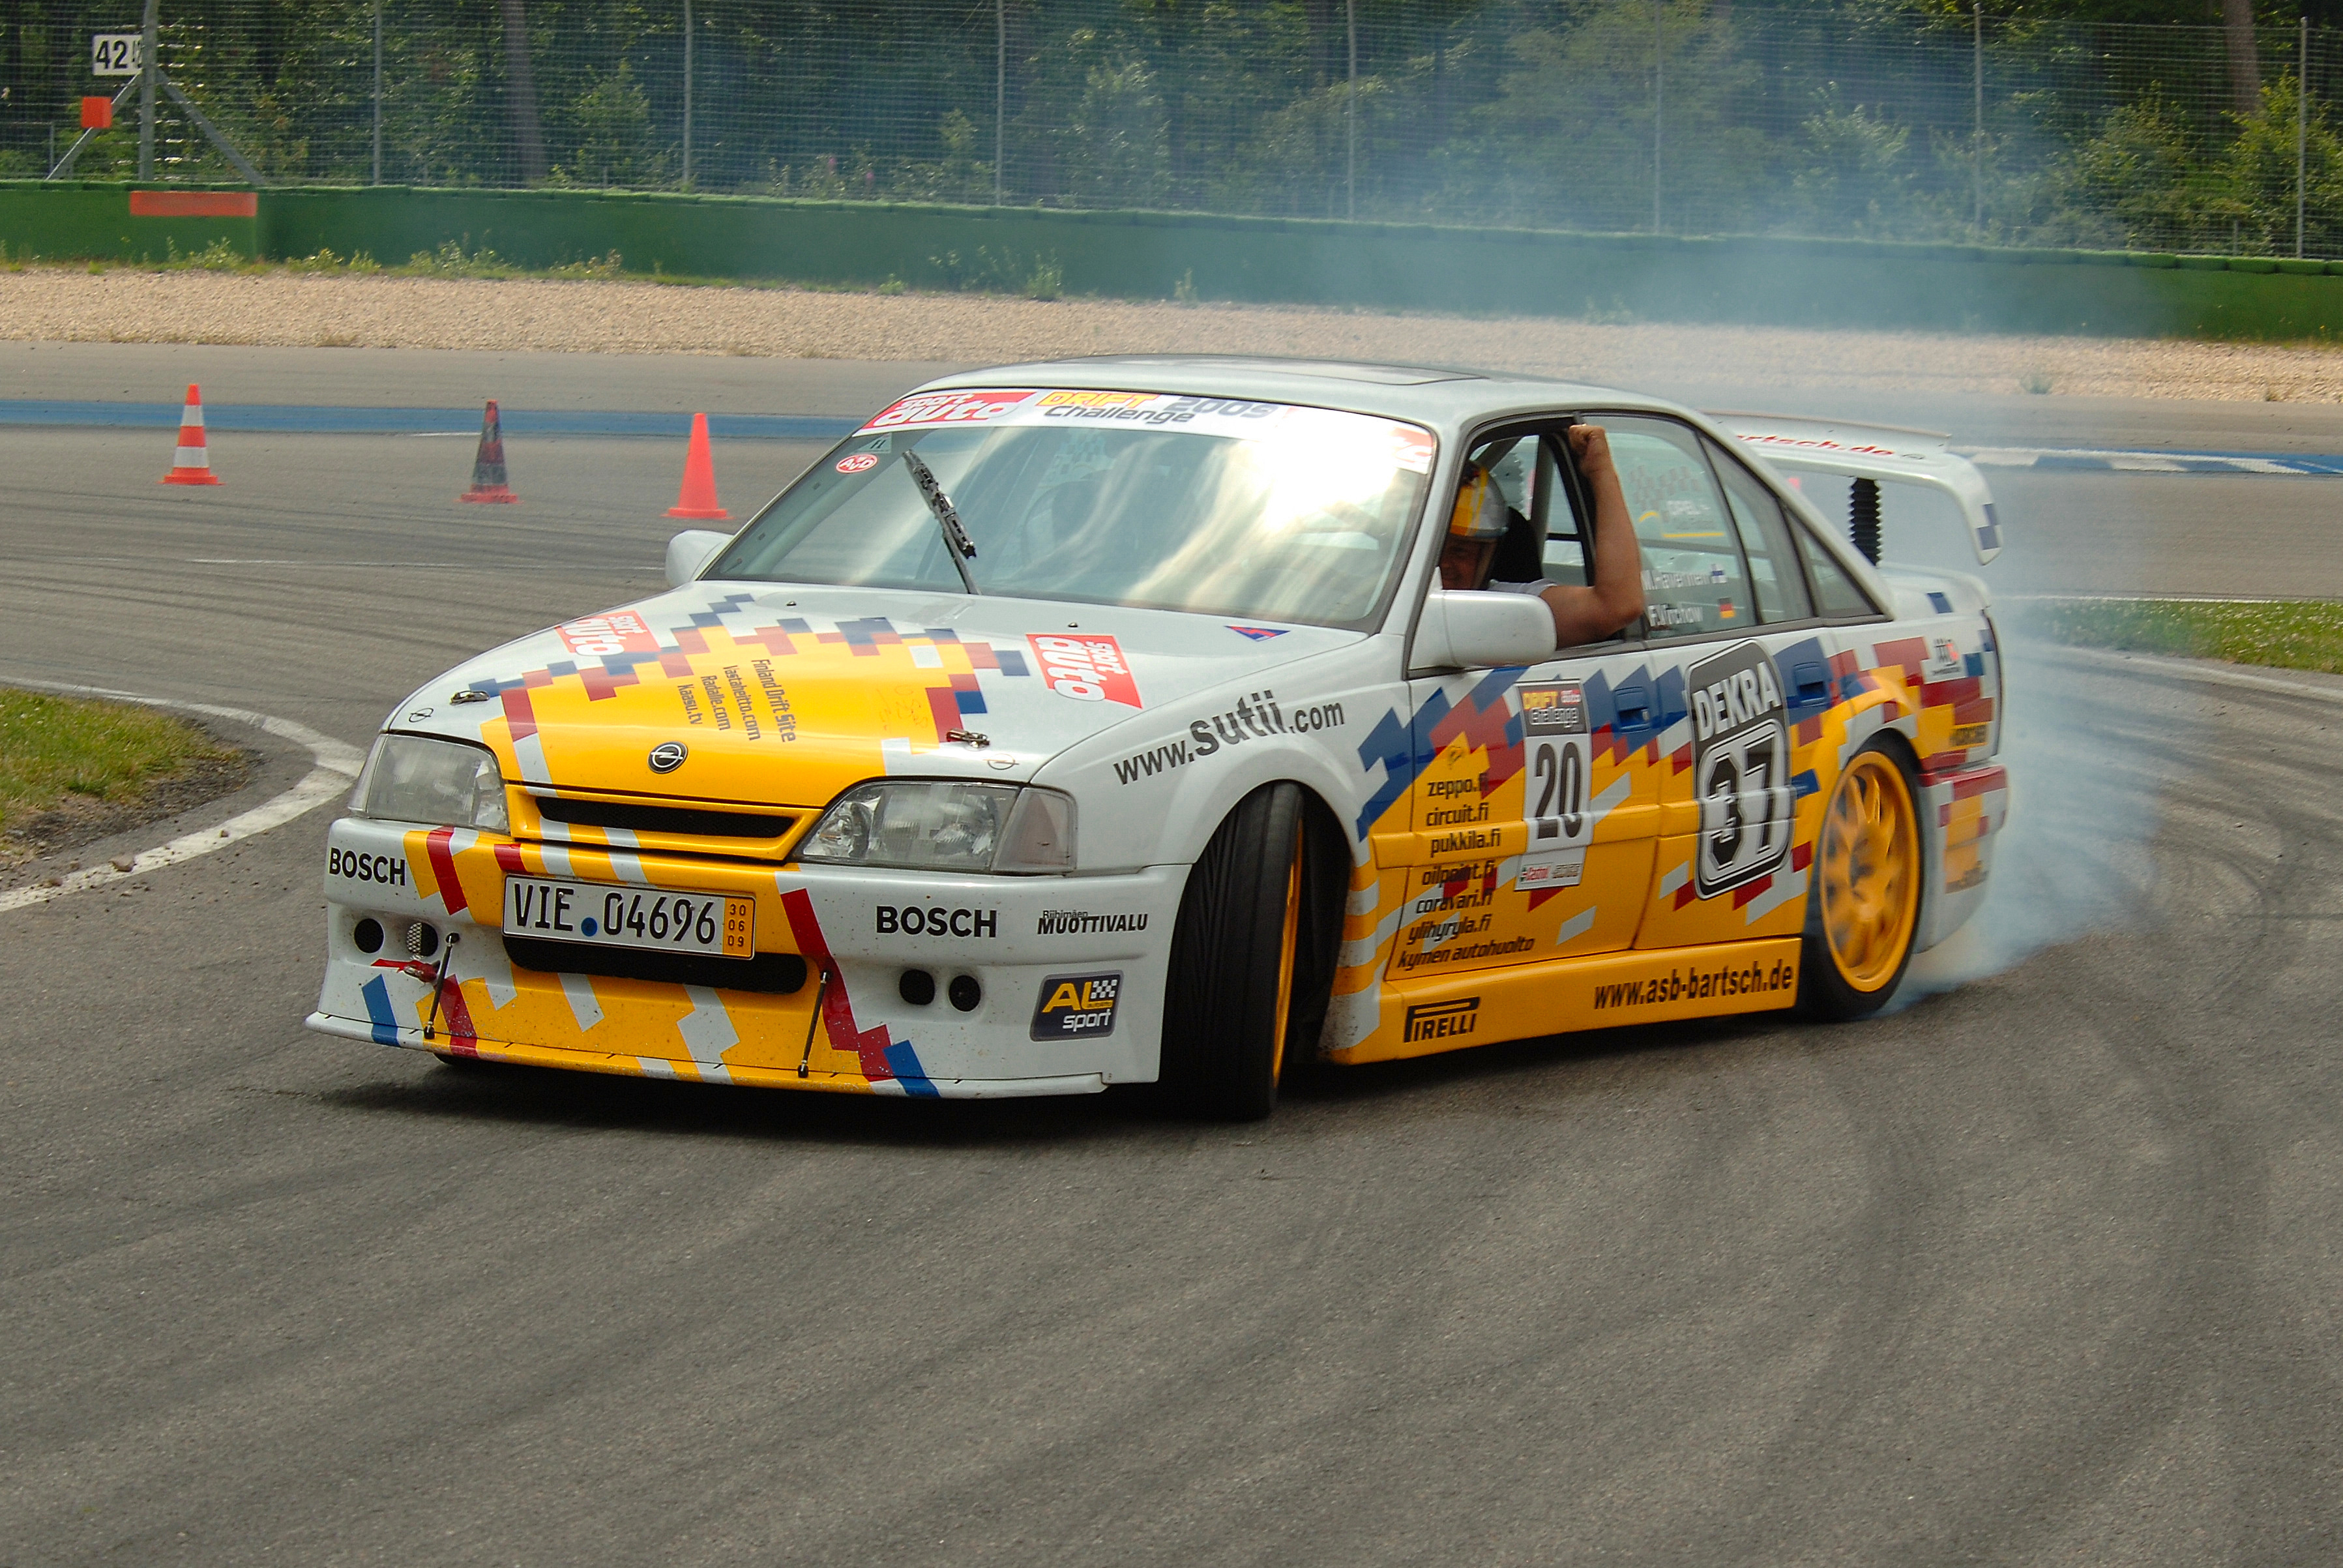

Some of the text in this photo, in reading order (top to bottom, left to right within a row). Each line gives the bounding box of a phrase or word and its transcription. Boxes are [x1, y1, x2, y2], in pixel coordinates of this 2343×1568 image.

[873, 401, 1018, 426] auto
[895, 394, 975, 410] sport
[1035, 391, 1278, 419] DRIFT 2009
[1043, 406, 1196, 424] Challenge
[562, 618, 626, 656] auto
[1035, 637, 1107, 702] auto
[1085, 641, 1129, 675] sport
[677, 684, 703, 725] Kaasu.tv
[700, 675, 731, 731] Radalle.com
[751, 659, 797, 743] Finland Drift Site
[1692, 660, 1782, 742] DEKRA
[1113, 689, 1346, 786] www.sutii.com
[1427, 772, 1489, 799] zeppo.fi
[1534, 741, 1582, 840] 20
[1708, 729, 1778, 872] 37
[1426, 802, 1489, 826] circuit.fi
[1430, 828, 1501, 858] pukkila.fi
[329, 847, 405, 886] BOSCH
[514, 883, 716, 944] VIE 04696
[728, 919, 745, 932] 06
[729, 903, 746, 916] 30
[876, 906, 997, 938] BOSCH
[1037, 913, 1148, 935] MUOTTIVALU
[727, 934, 744, 947] 09
[1397, 950, 1452, 971] kymen
[1043, 981, 1113, 1013] AL
[1594, 958, 1793, 1009] www.asb-bartsch.de
[1063, 1009, 1112, 1032] sport
[1404, 996, 1481, 1043] PIRELLI
